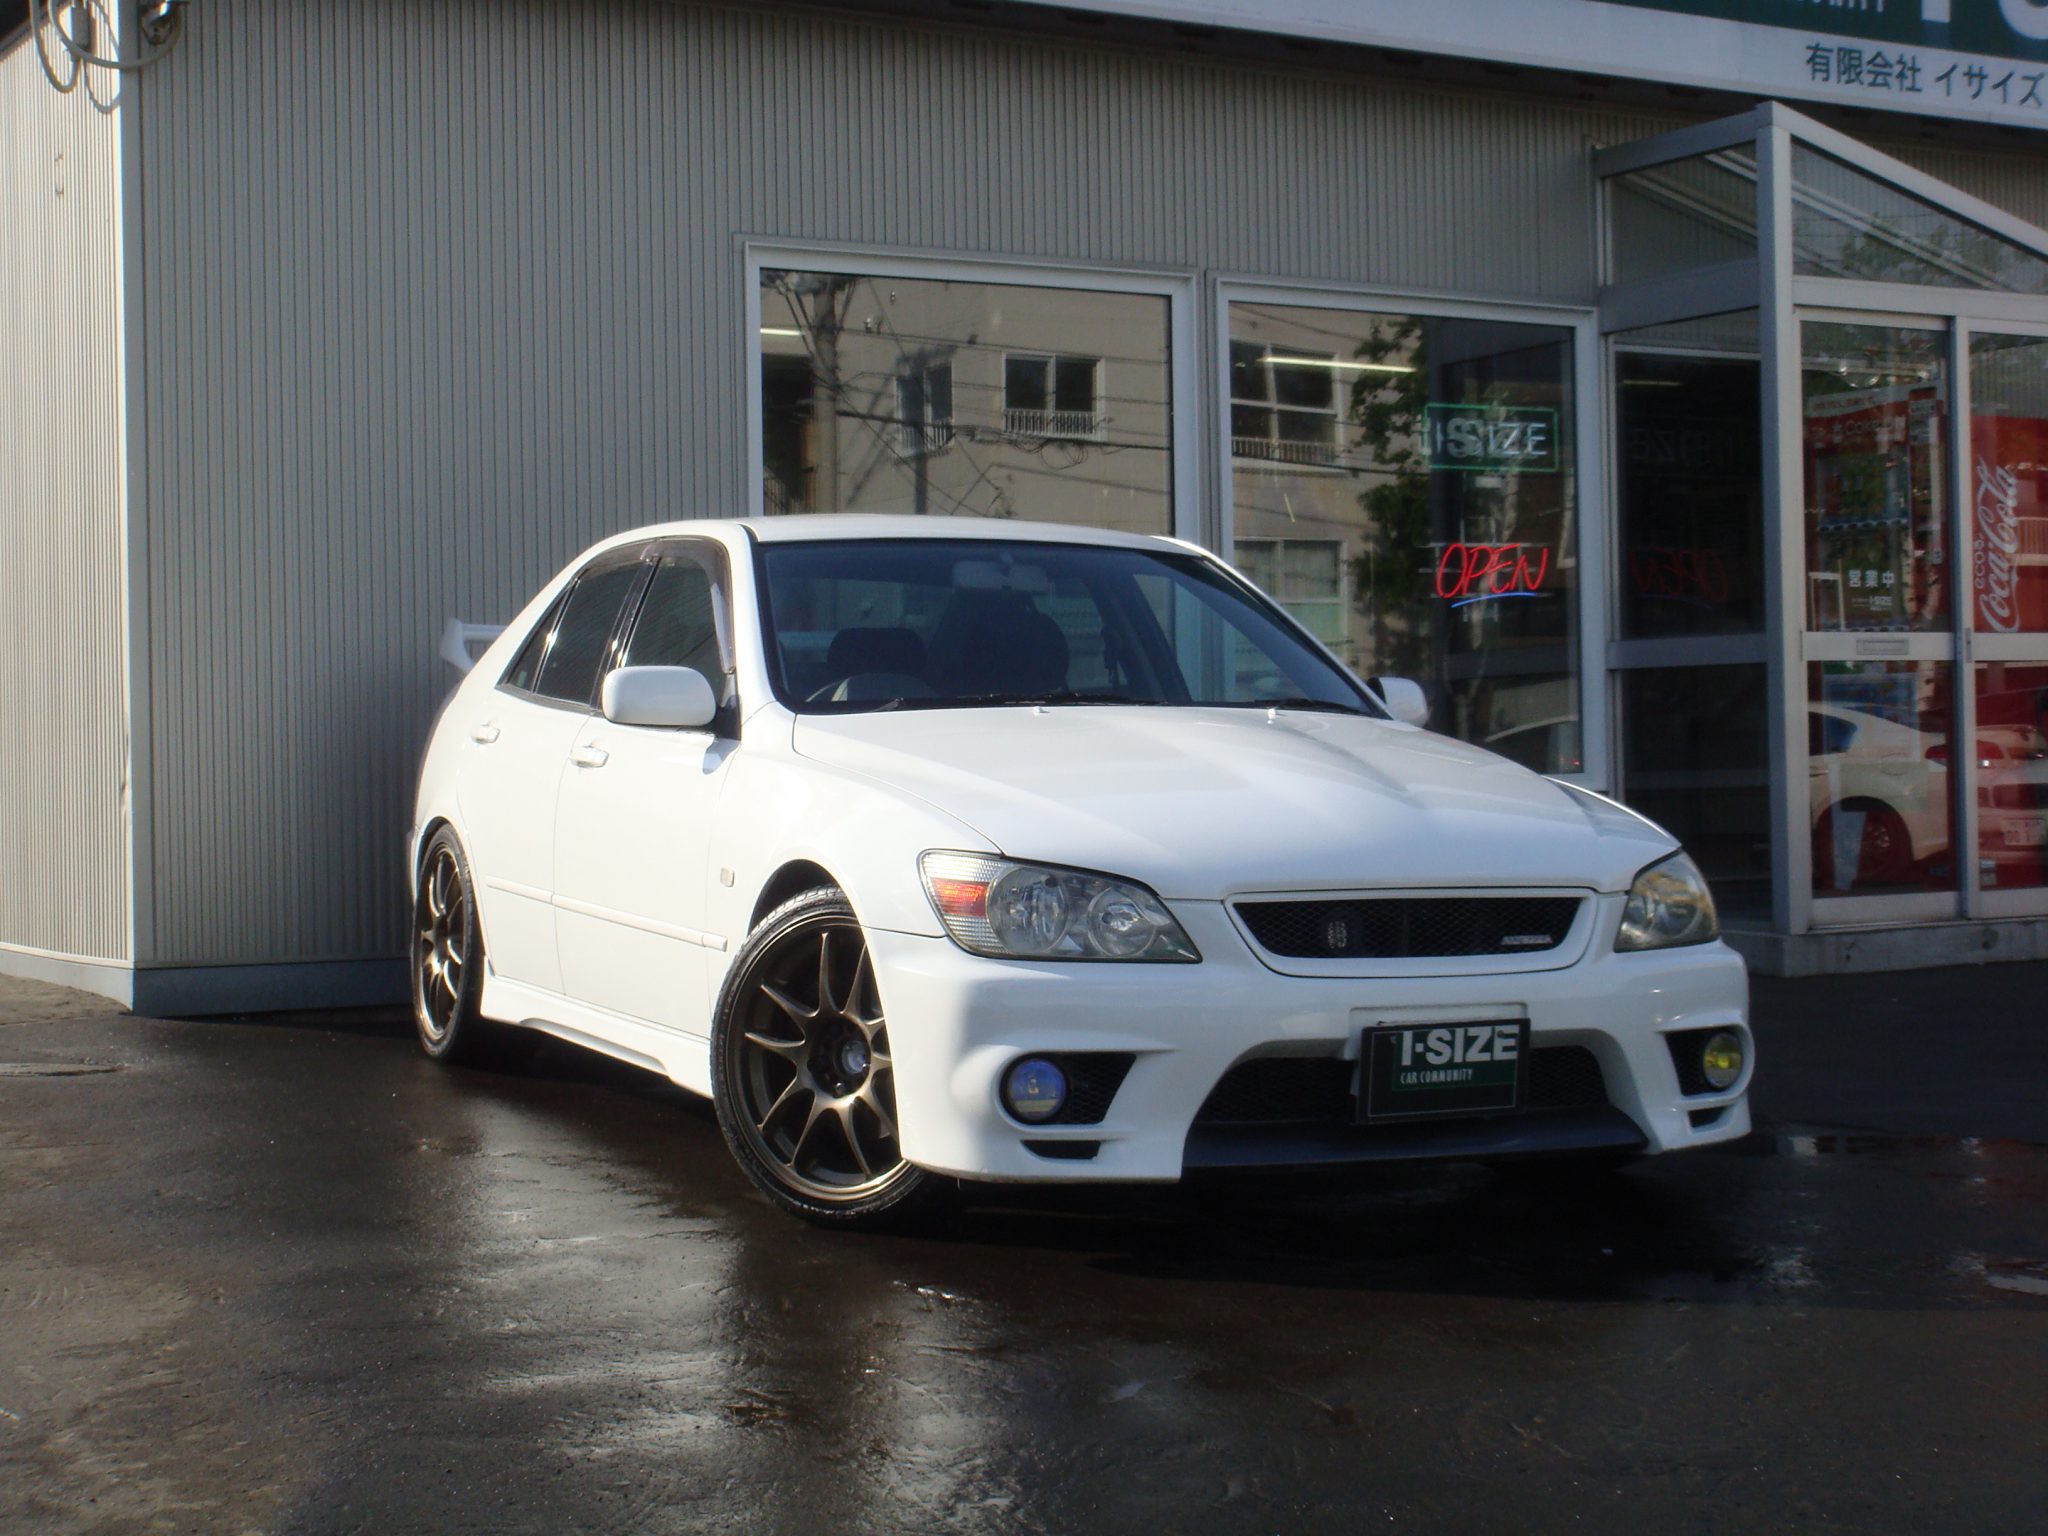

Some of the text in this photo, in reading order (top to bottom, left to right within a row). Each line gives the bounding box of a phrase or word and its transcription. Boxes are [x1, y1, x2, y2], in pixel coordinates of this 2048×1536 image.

[1805, 42, 2046, 107] 有限会社 イサイズ
[1436, 543, 1549, 598] OPEN
[1400, 1024, 1520, 1066] I-SIZE
[1400, 1068, 1473, 1085] CAR COMMUNITY
